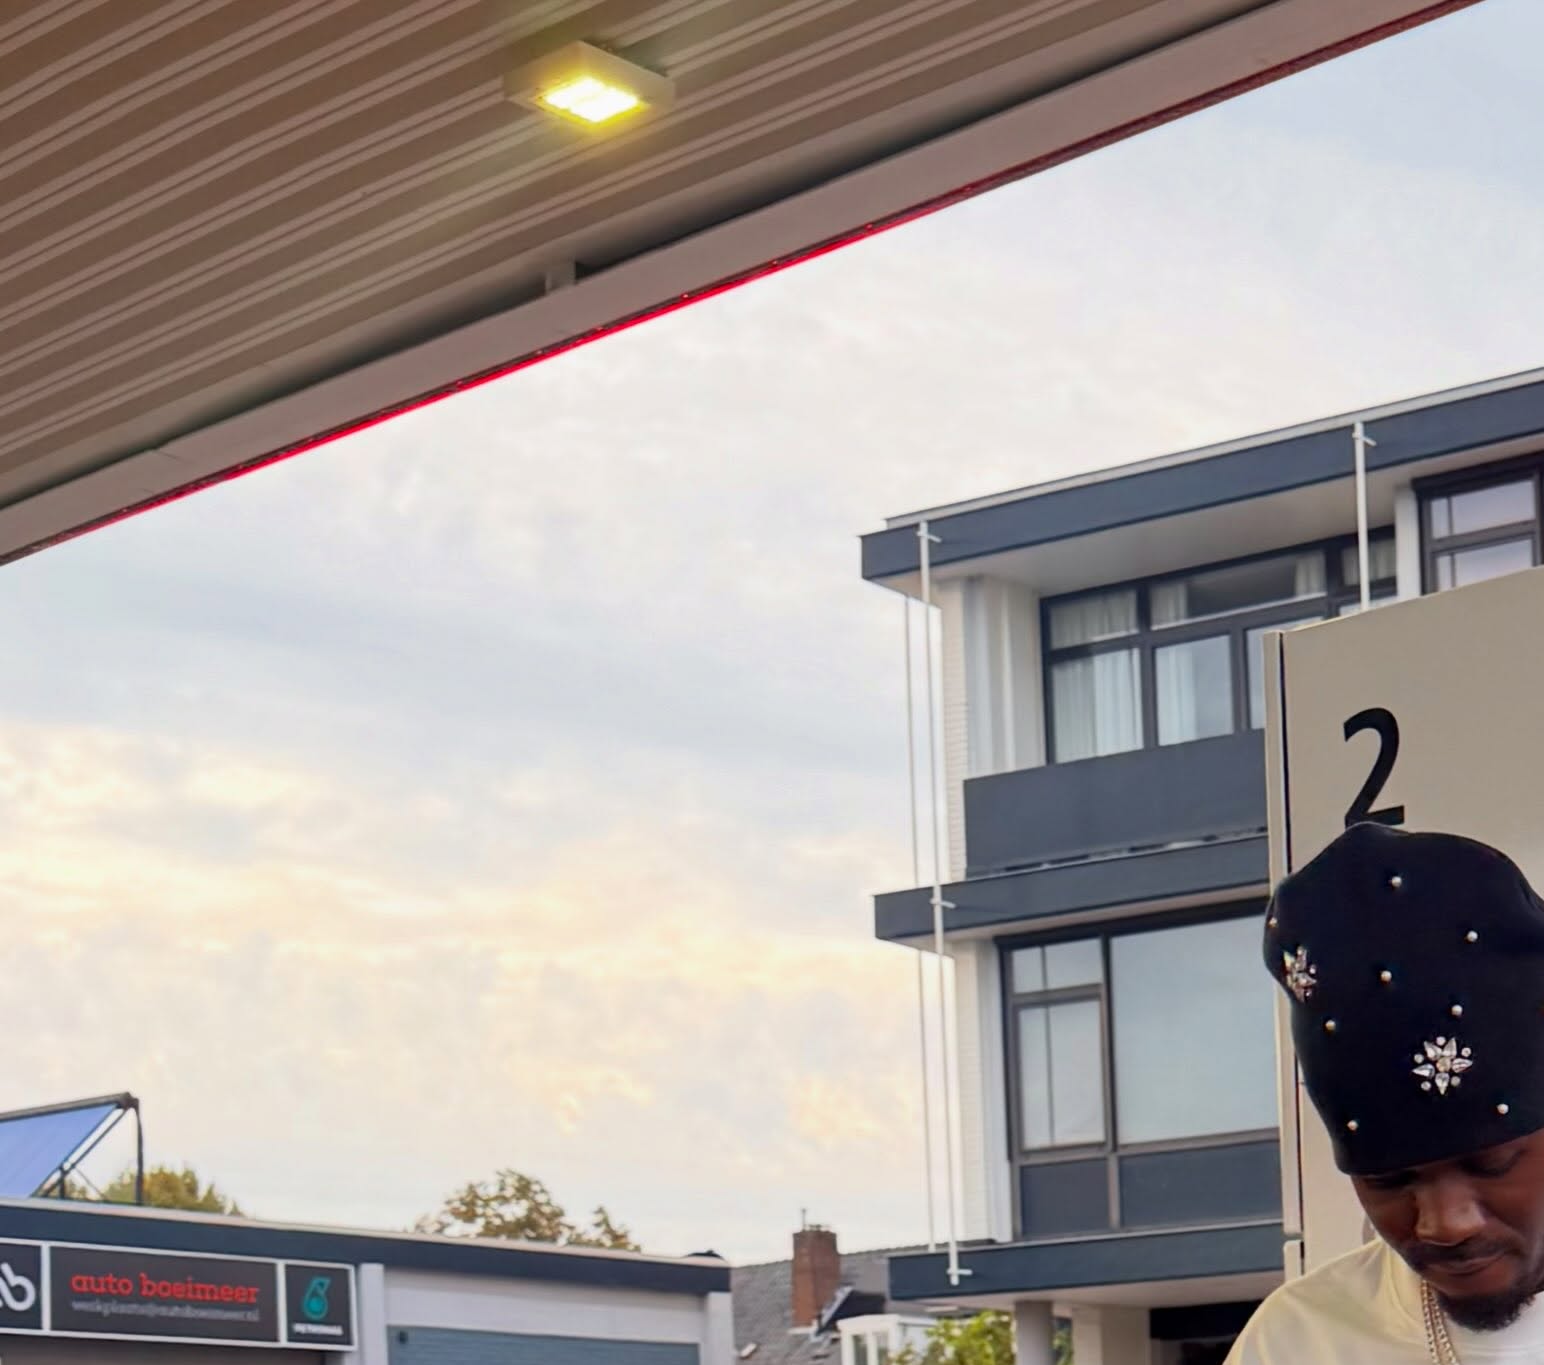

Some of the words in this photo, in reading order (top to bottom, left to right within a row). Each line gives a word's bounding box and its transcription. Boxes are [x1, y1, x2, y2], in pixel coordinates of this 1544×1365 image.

[1343, 707, 1405, 828] 2
[70, 1273, 133, 1297] auto
[138, 1271, 260, 1304] boeimeer
